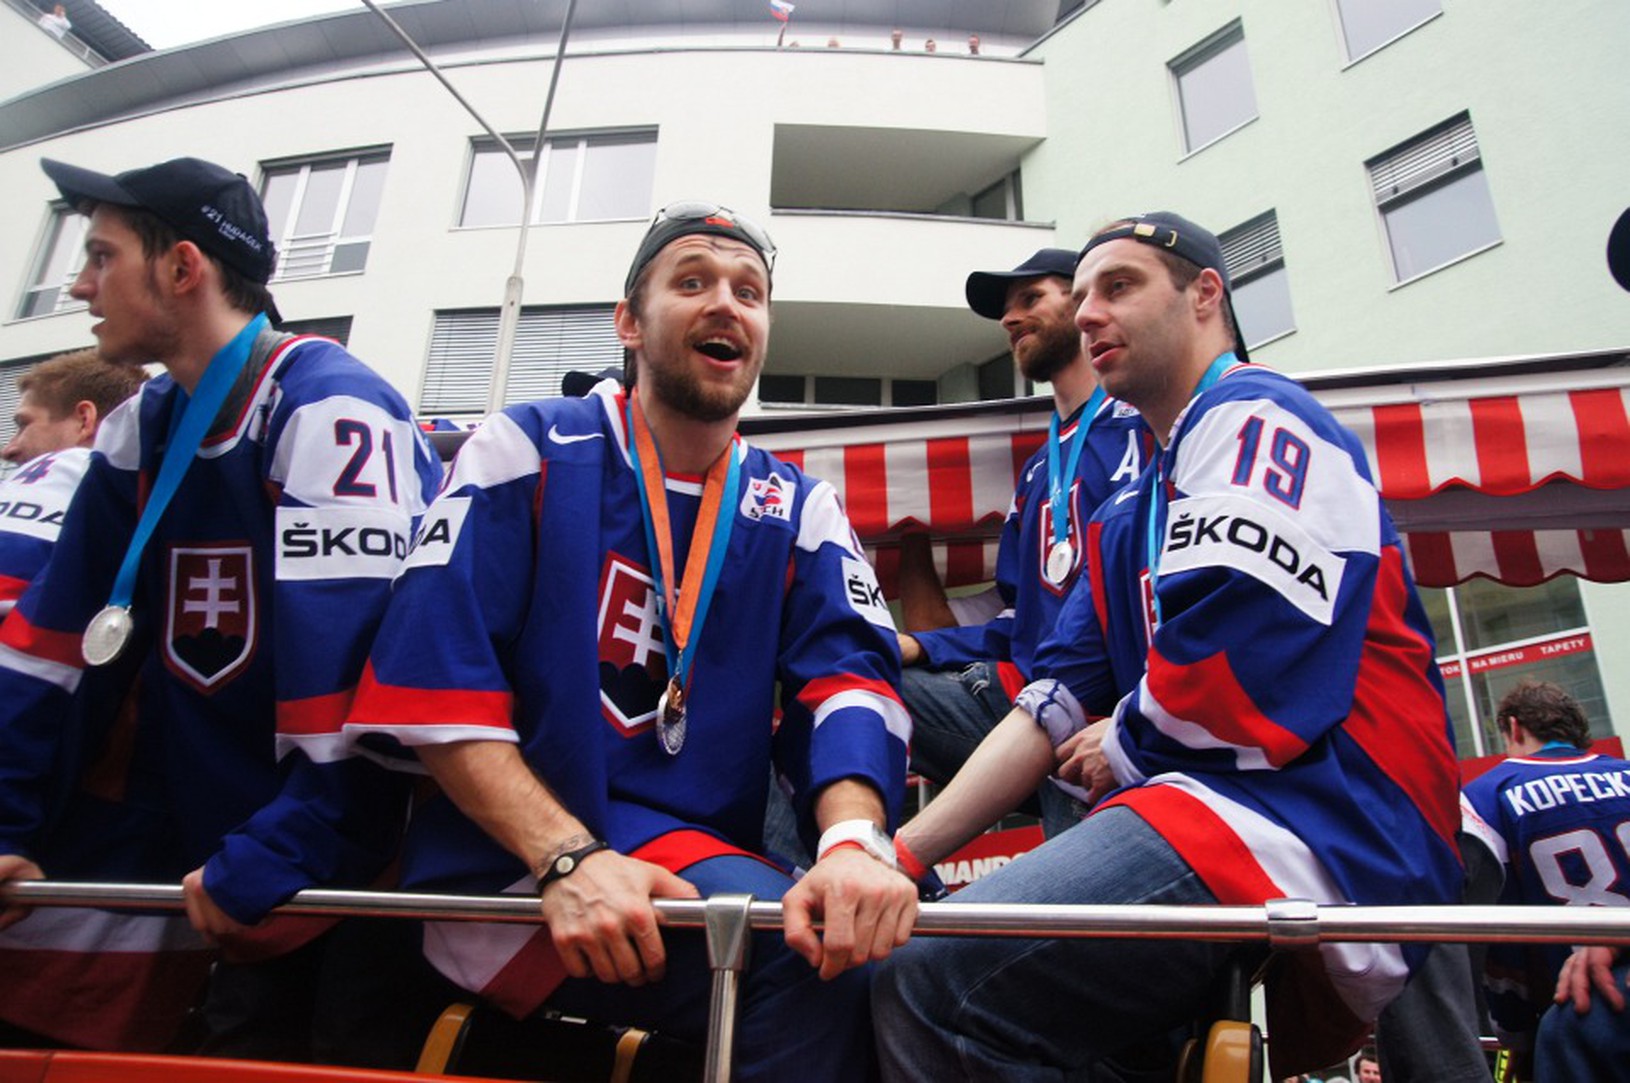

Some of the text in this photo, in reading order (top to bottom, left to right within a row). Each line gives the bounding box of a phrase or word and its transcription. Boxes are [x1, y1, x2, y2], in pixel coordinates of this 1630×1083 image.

[333, 418, 398, 505] 21
[1110, 429, 1140, 483] A
[1231, 415, 1311, 511] 19
[1167, 512, 1328, 602] ŠKODA
[1540, 637, 1585, 654] TAPETY
